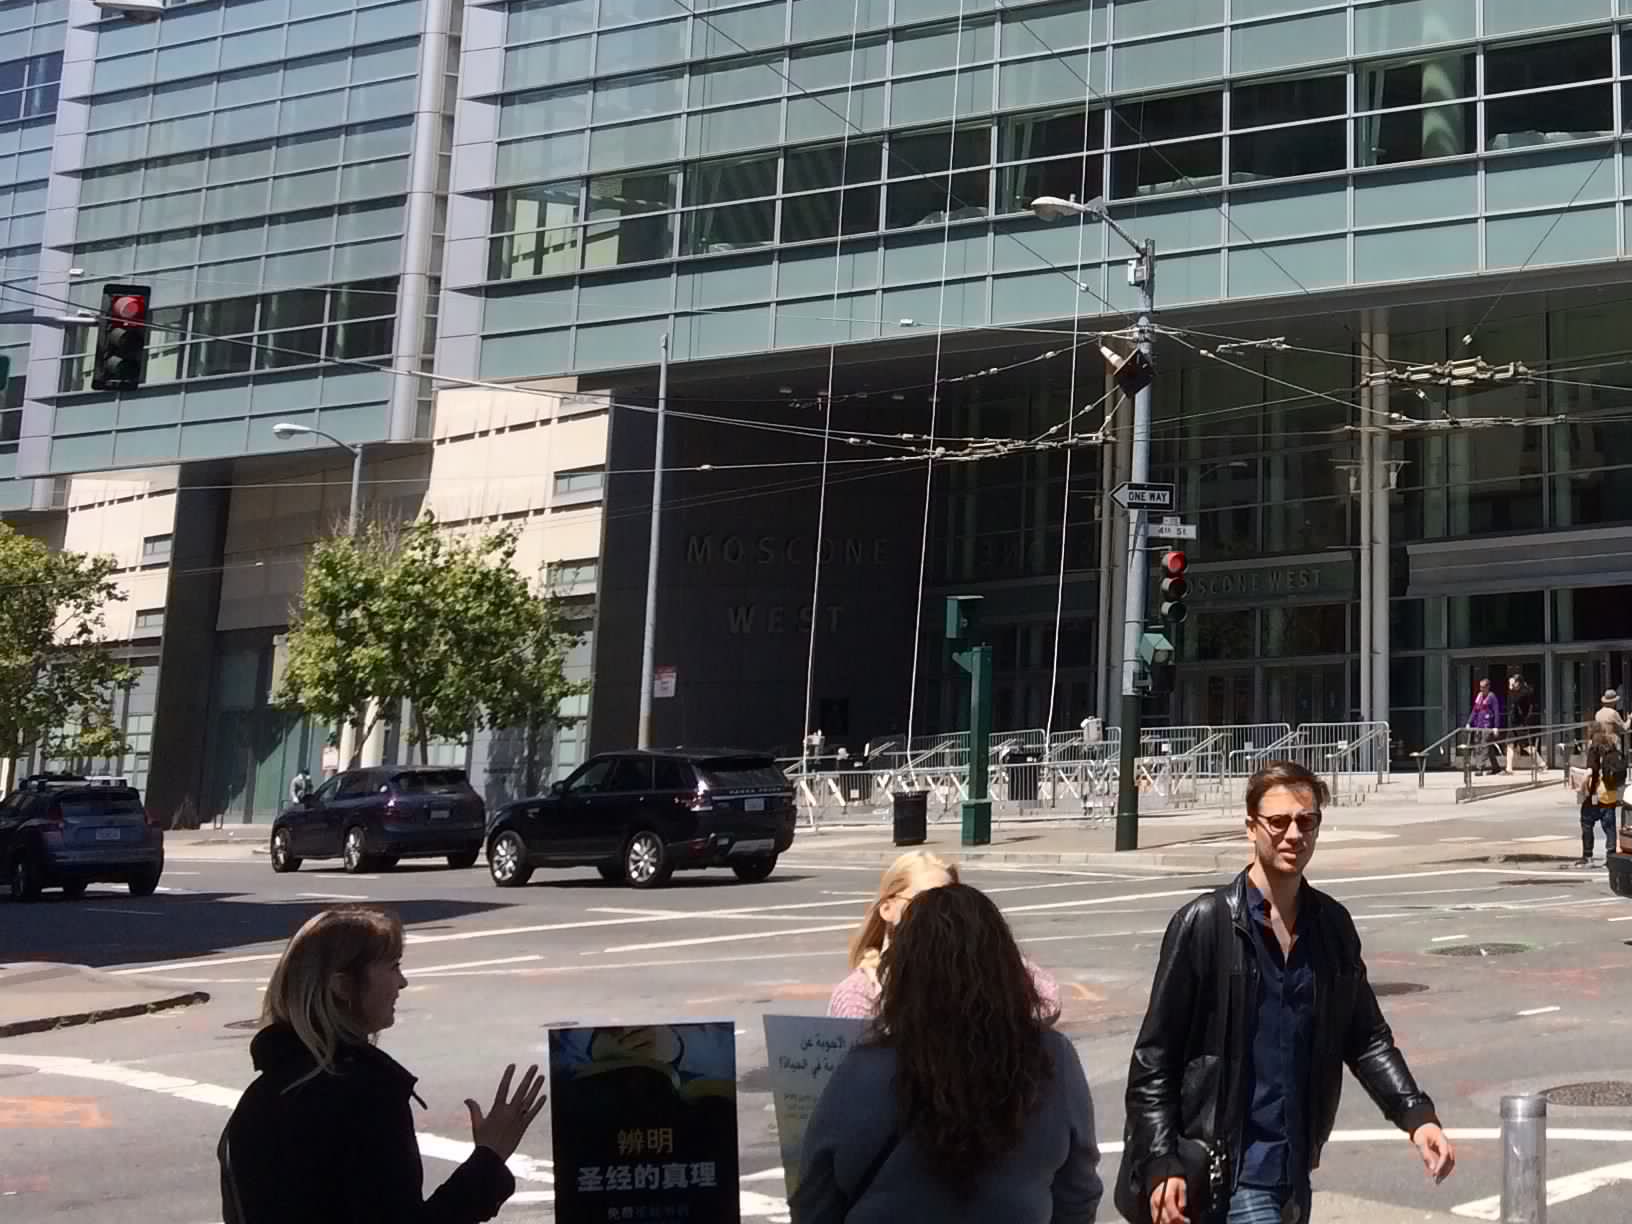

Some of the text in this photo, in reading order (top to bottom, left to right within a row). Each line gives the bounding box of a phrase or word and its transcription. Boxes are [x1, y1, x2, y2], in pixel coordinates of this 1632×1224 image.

[1128, 491, 1168, 502] ONE WAY
[686, 534, 889, 566] MOSCONE
[1270, 568, 1322, 593] WEST
[727, 606, 846, 634] WEST
[577, 1160, 718, 1193] 圣经的真理
